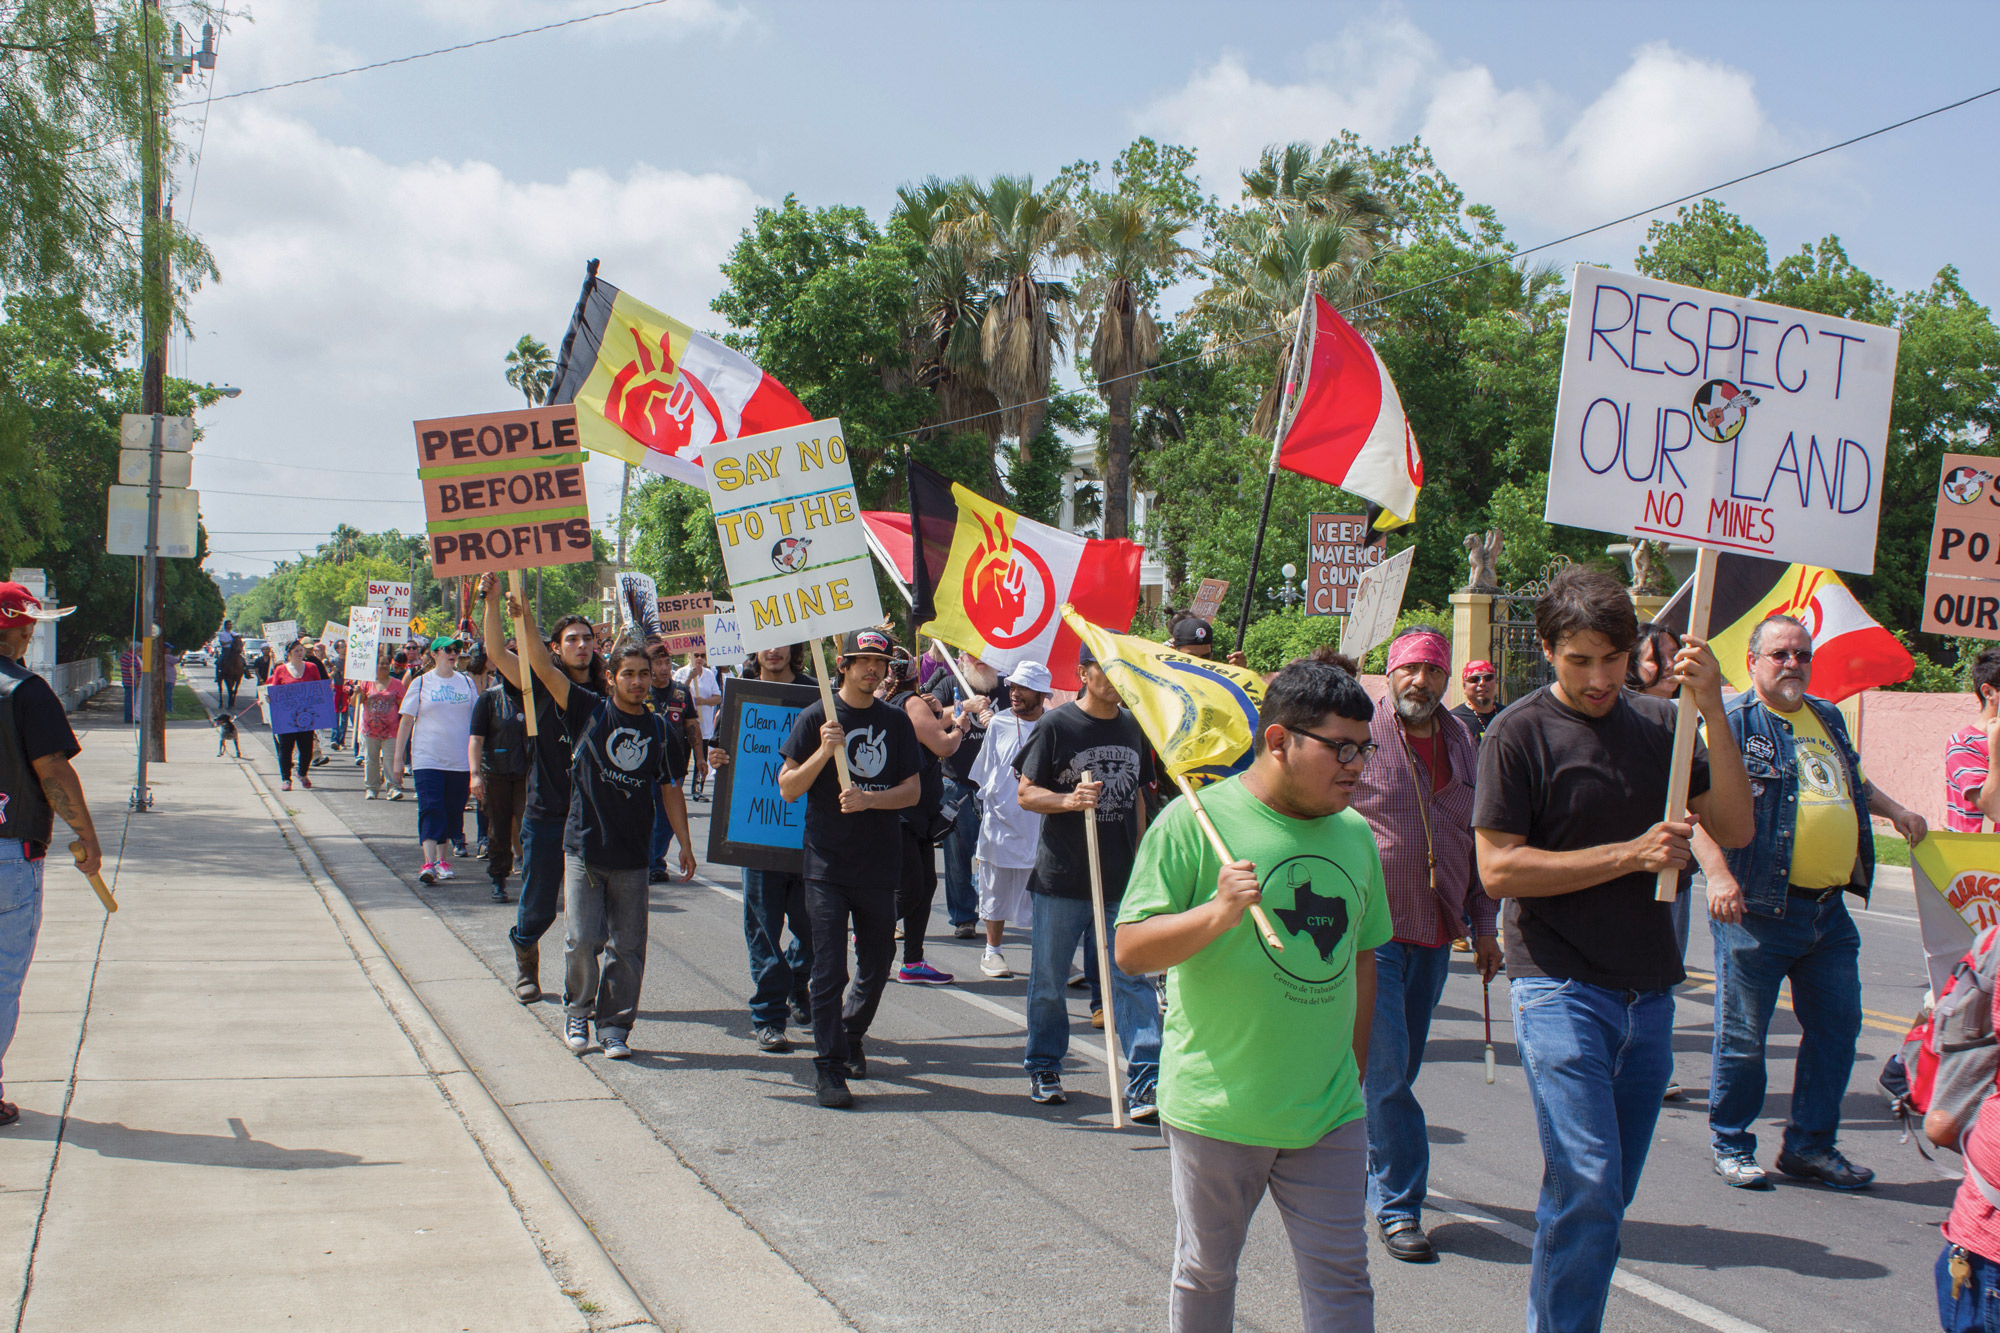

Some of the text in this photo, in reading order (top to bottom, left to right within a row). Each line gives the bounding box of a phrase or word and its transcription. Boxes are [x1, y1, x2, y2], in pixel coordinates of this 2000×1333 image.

[1587, 284, 1866, 400] RESPECT
[421, 417, 578, 462] PEOPLE
[713, 435, 847, 491] SAY NO
[1580, 397, 1872, 515] OUR LAND
[438, 467, 582, 513] BEFORE
[717, 491, 855, 547] TO THE
[1644, 489, 1775, 545] NO MINES
[433, 518, 593, 565] PROFITS
[1316, 521, 1364, 543] KEEP
[1310, 543, 1387, 567] MAVERICK
[1938, 527, 2000, 566] PO
[1318, 565, 1370, 586] COUN
[369, 584, 410, 597] SAY NO
[386, 606, 409, 618] THE
[657, 596, 711, 613] RESPECT
[750, 577, 854, 631] MINE
[1932, 593, 2000, 631] OUR
[382, 626, 402, 637] INE
[659, 619, 680, 633] OUR
[1200, 663, 1240, 679] del
[745, 707, 776, 731] Clean
[742, 733, 772, 754] Clean
[1086, 747, 1133, 762] Fender
[602, 768, 644, 789] AIMCTX
[747, 796, 799, 827] MINE
[1307, 916, 1334, 927] CTFV
[1273, 972, 1298, 990] Centro
[1298, 985, 1308, 993] de
[1284, 991, 1336, 1006] Fuerza del Valle
